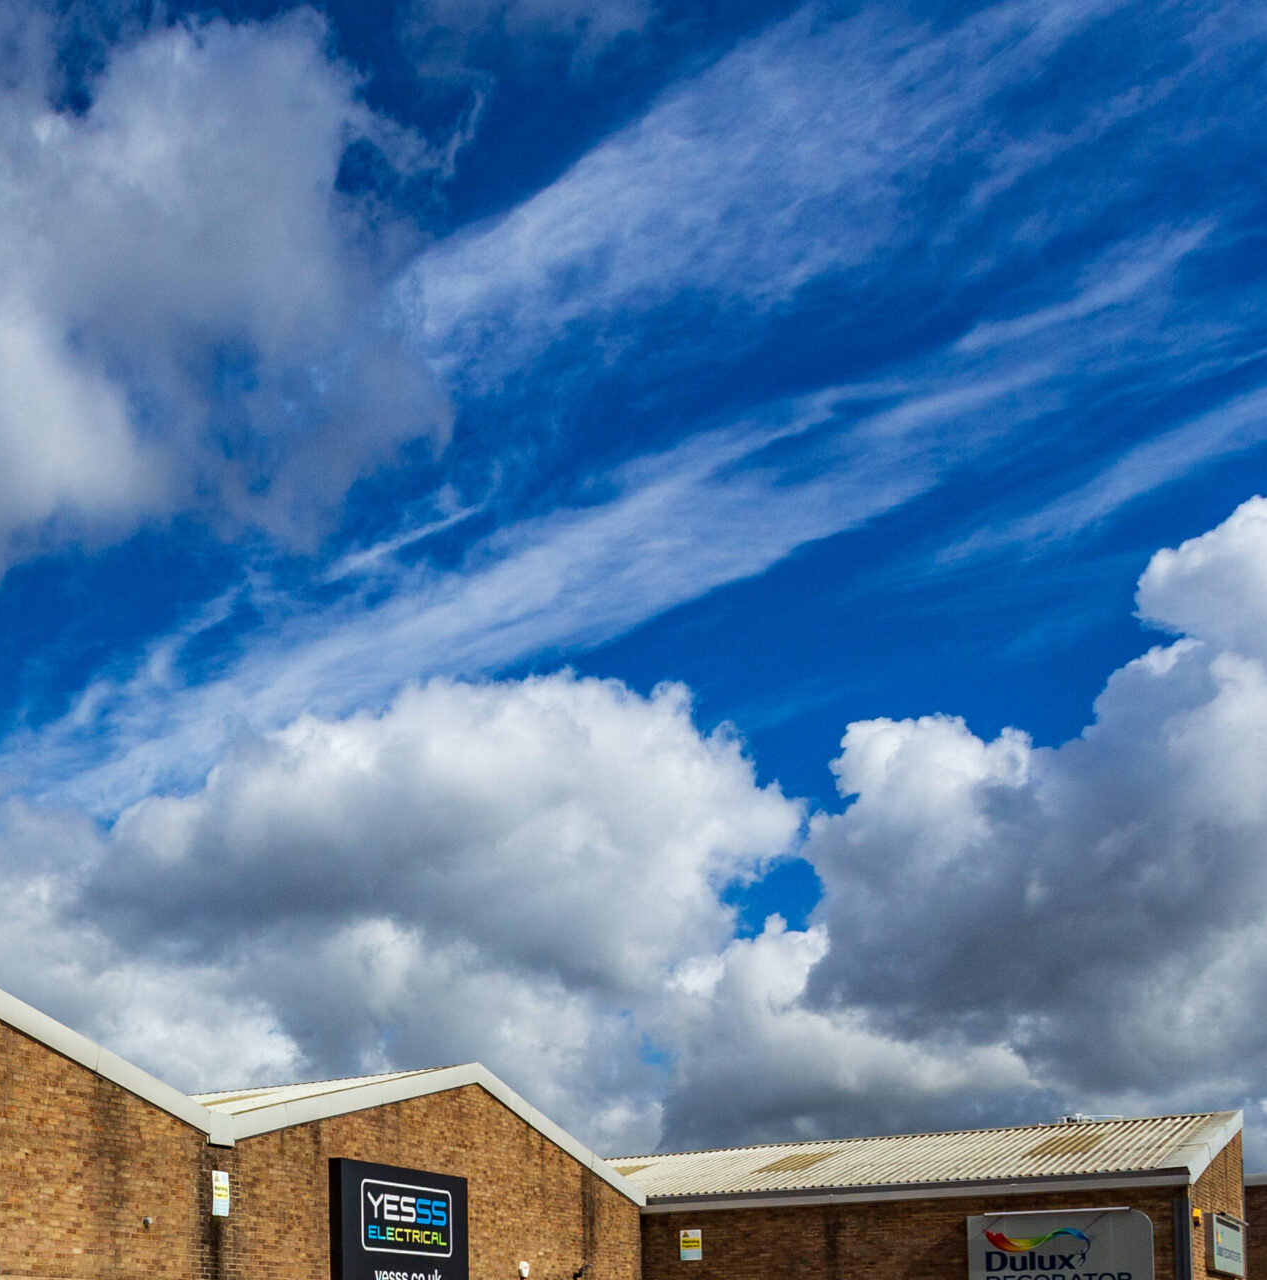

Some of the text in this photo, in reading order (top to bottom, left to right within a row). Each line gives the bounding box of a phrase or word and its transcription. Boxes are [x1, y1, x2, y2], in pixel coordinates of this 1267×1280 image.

[367, 1191, 447, 1226] YESSS
[368, 1224, 448, 1246] ELECTRICAL
[985, 1251, 1076, 1272] Dulux
